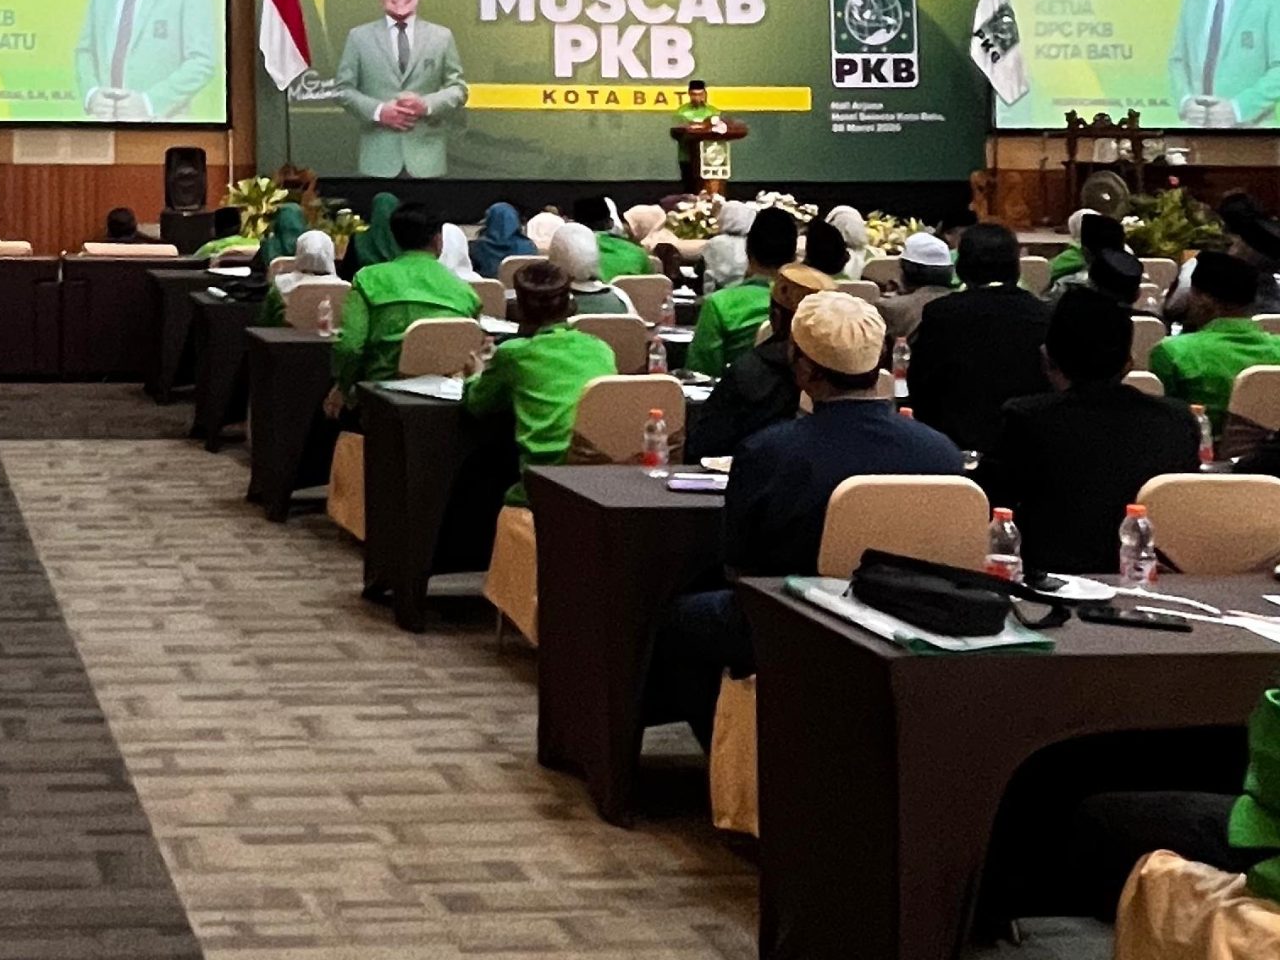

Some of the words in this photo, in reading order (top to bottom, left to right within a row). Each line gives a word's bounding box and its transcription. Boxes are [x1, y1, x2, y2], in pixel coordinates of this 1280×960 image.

[1034, 21, 1072, 38] DPC
[1077, 21, 1114, 38] PKB
[553, 23, 696, 79] PKB
[1034, 44, 1081, 59] KOTA
[1087, 44, 1133, 60] BATU
[835, 57, 916, 83] PKB
[542, 90, 620, 106] KOTA
[633, 90, 707, 106] BAT
